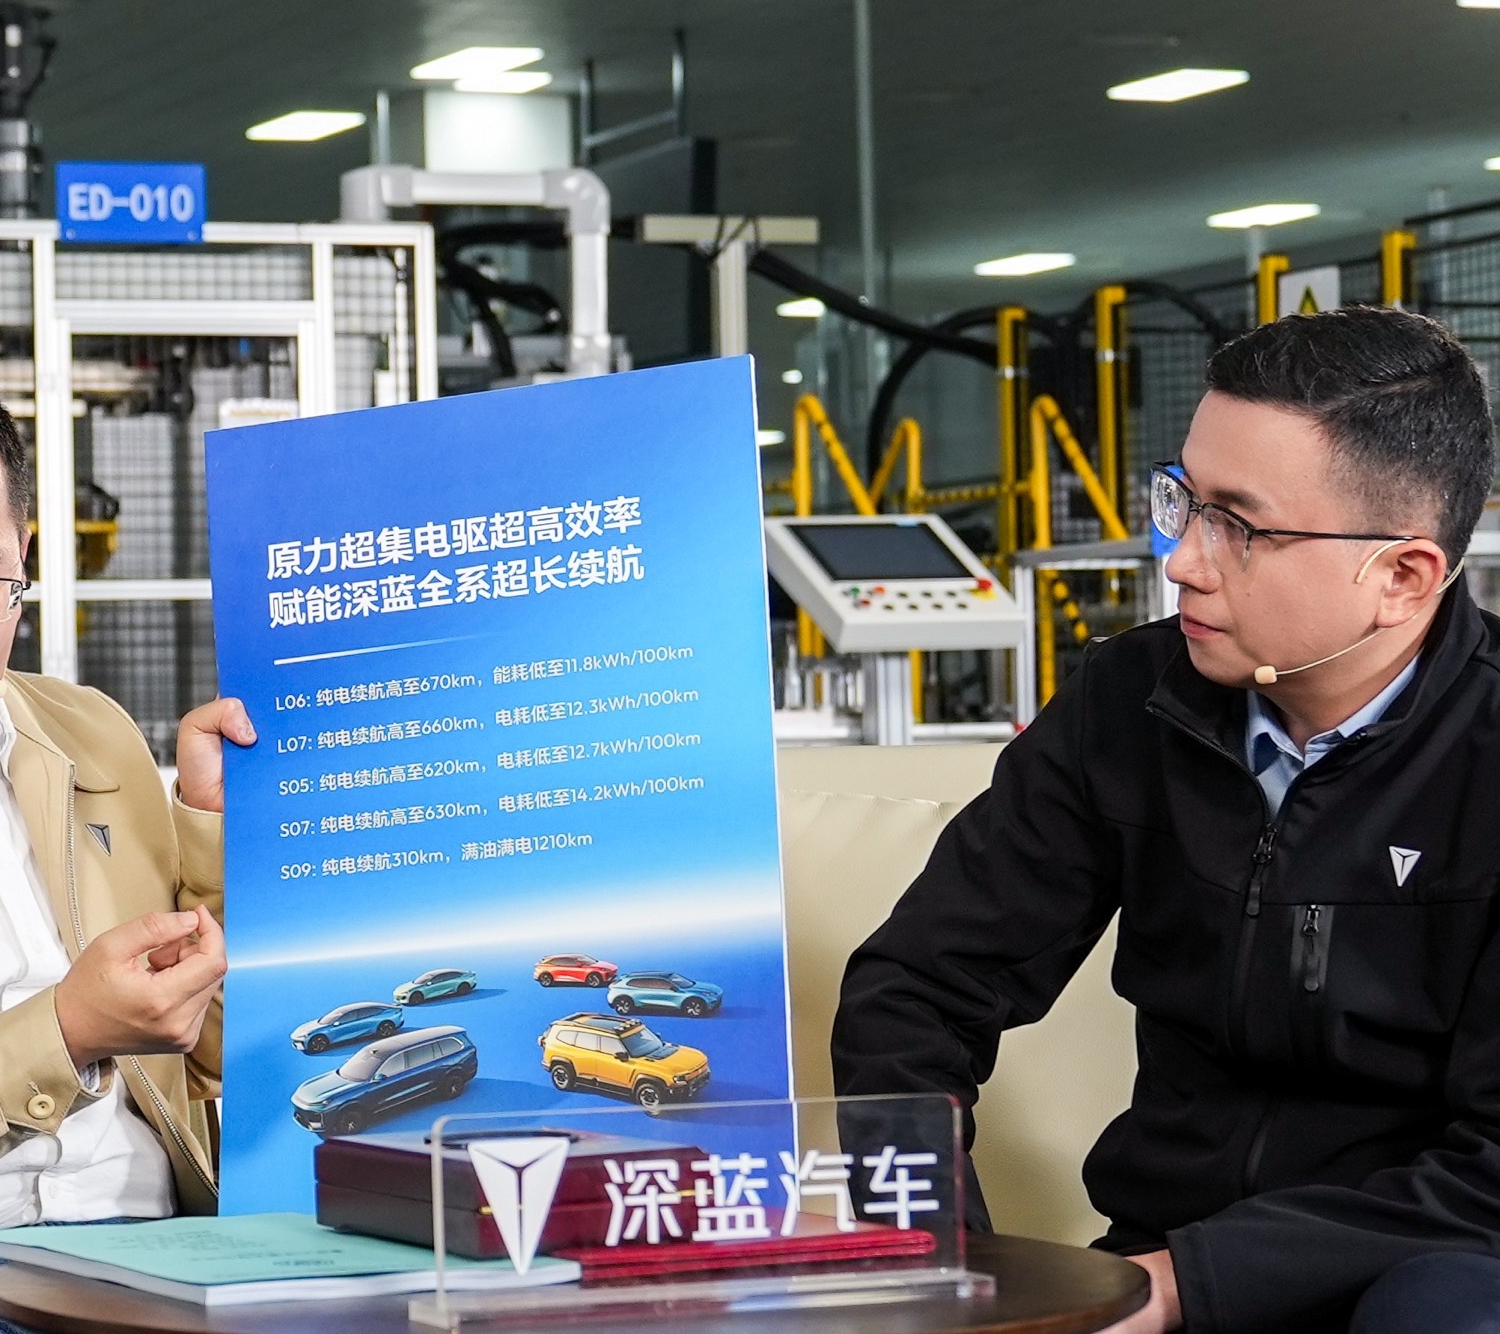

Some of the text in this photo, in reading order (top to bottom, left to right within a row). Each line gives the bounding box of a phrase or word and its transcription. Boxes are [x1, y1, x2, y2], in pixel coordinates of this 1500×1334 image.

[68, 182, 195, 223] ED-010
[266, 495, 642, 581] 原力超集电驱超高效率
[268, 544, 645, 629] 赋能深蓝全系超长续航
[603, 1145, 940, 1247] 深蓝汽车
